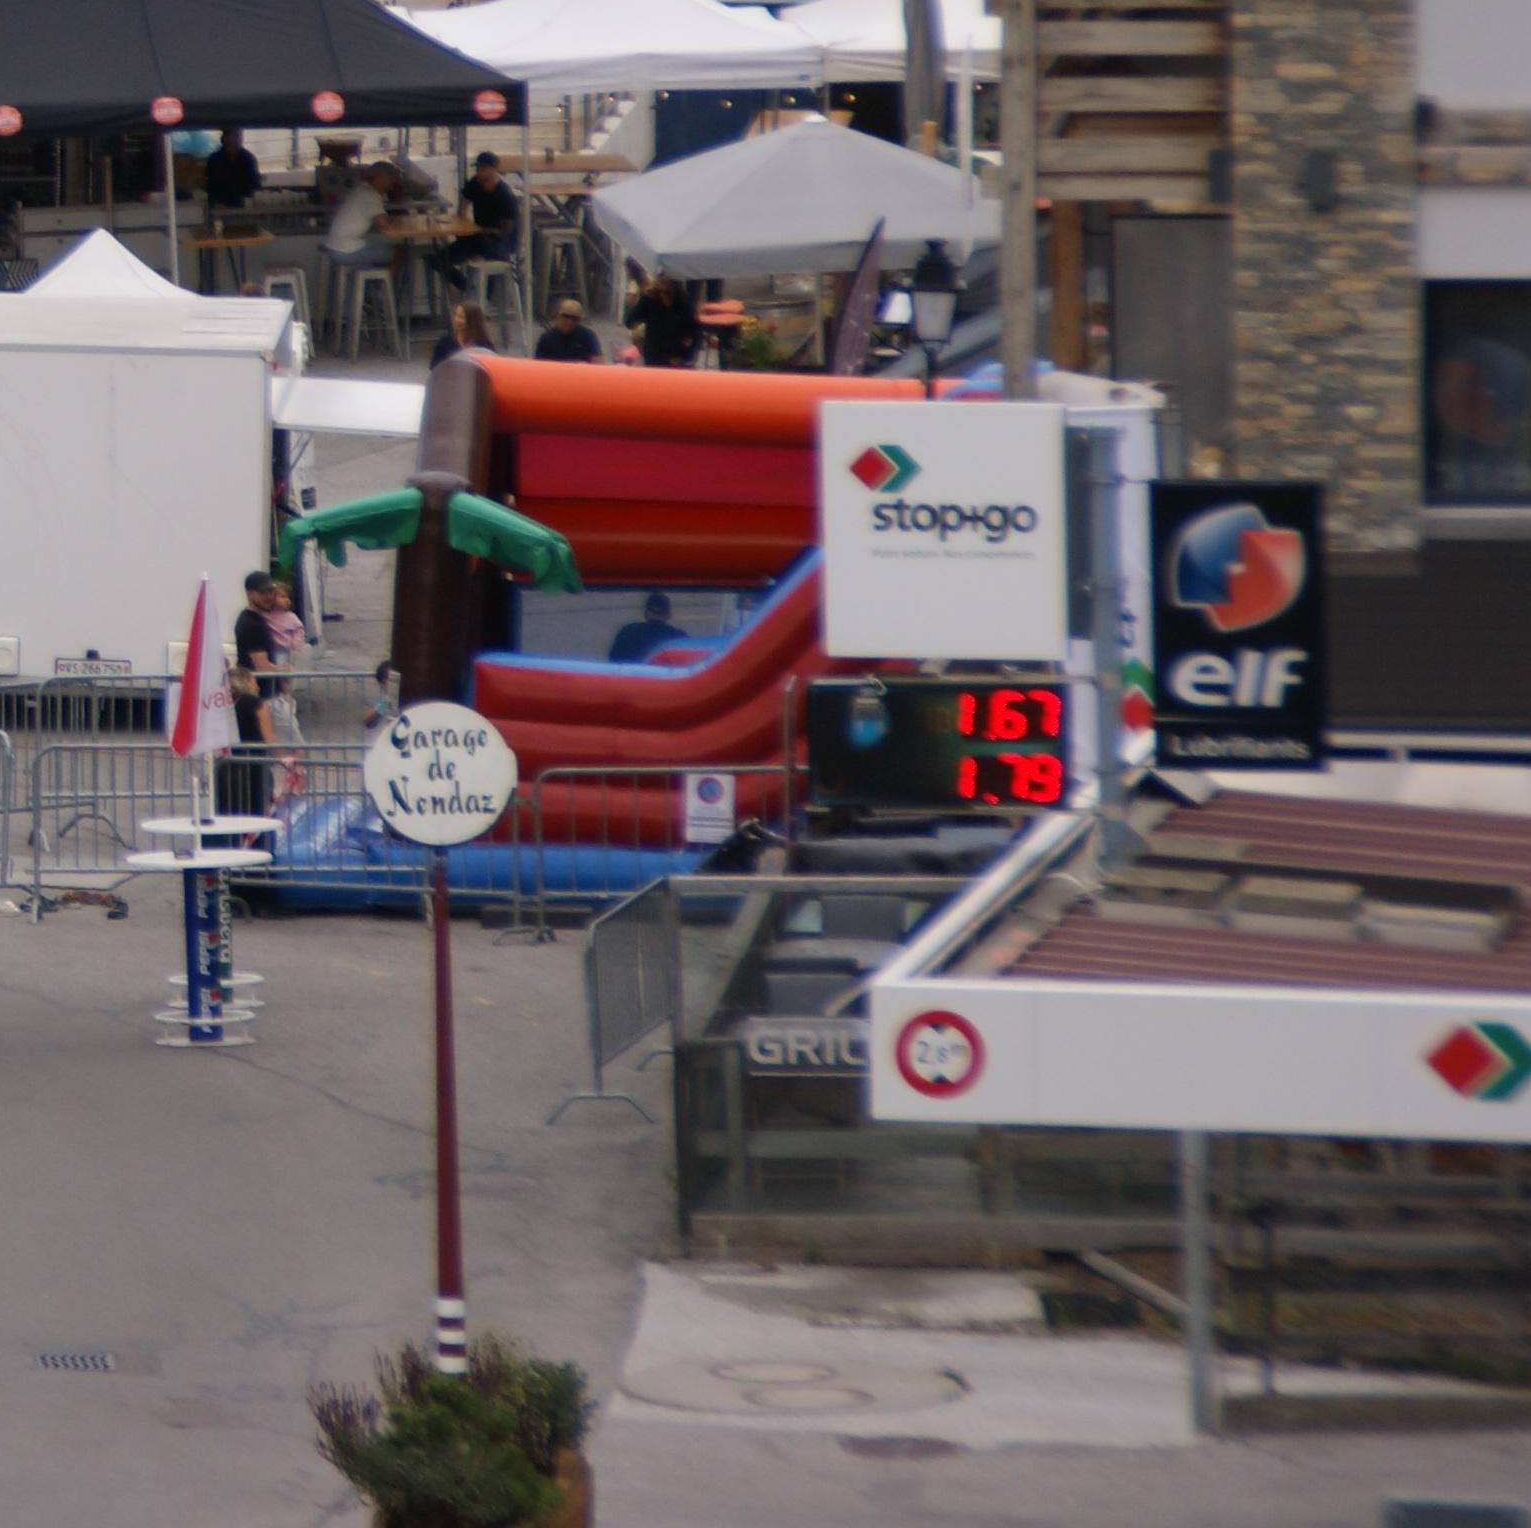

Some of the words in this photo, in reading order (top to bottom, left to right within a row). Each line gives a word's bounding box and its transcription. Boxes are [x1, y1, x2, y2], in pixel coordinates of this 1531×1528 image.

[1167, 646, 1310, 710] elf
[390, 714, 488, 759] Garage
[957, 688, 1062, 741] 1.67
[427, 748, 457, 781] de
[386, 775, 497, 817] Nendaz
[218, 866, 234, 964] arlsberg
[198, 930, 212, 976] PEPSI
